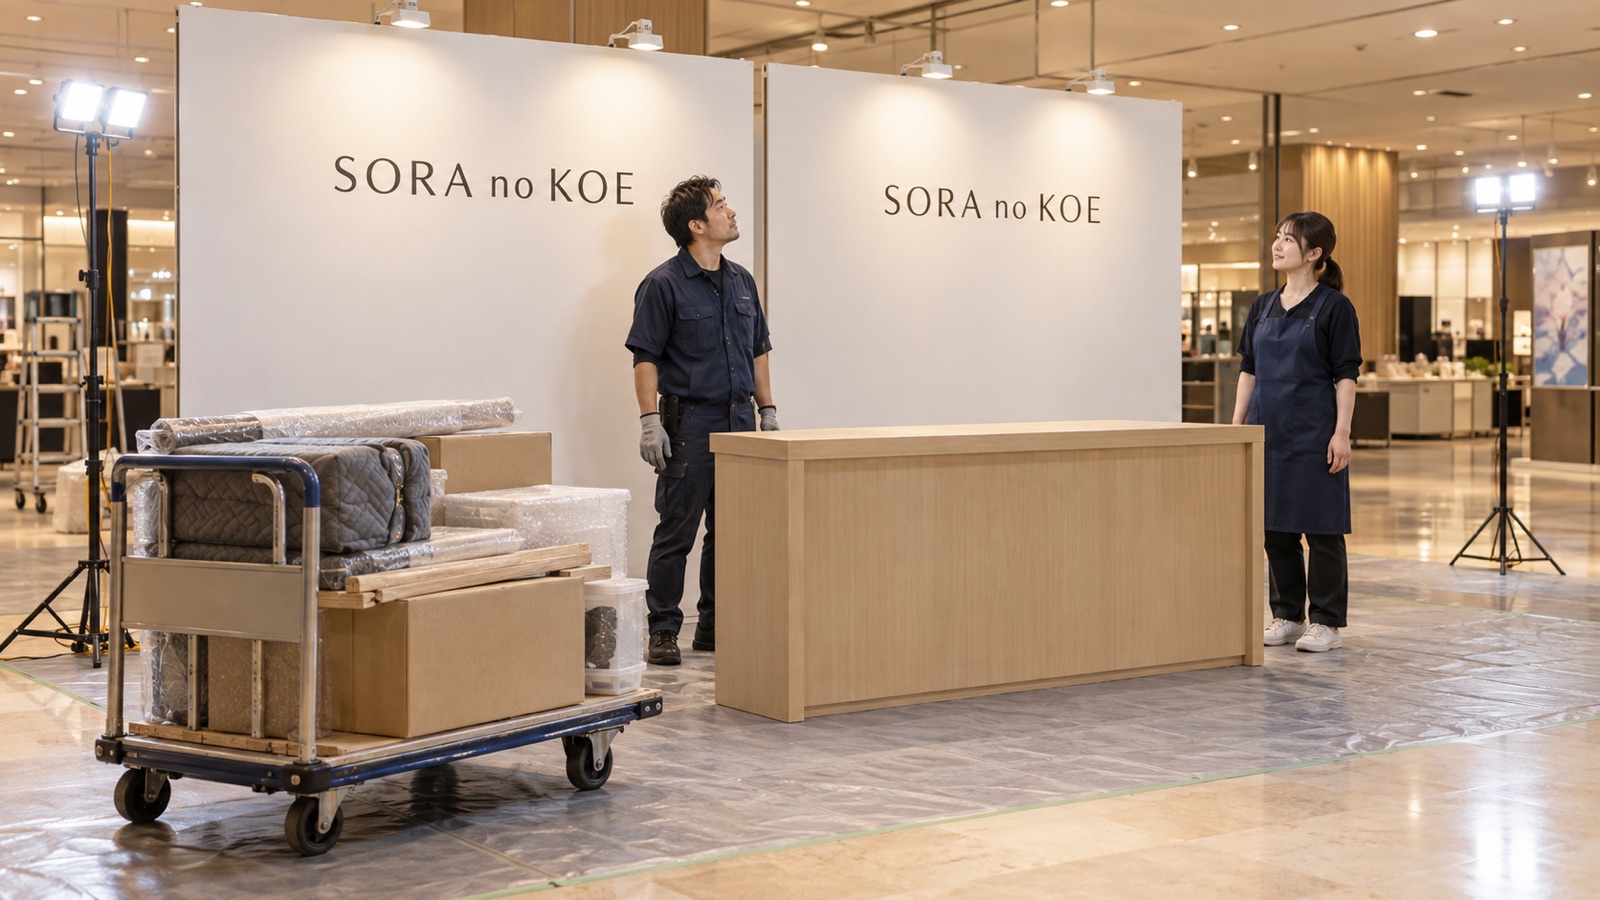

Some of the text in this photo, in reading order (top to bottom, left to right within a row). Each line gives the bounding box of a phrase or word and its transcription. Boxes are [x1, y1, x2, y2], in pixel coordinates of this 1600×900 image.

[334, 155, 634, 206] SORA no KOE
[884, 184, 1101, 224] SORA no KOE
